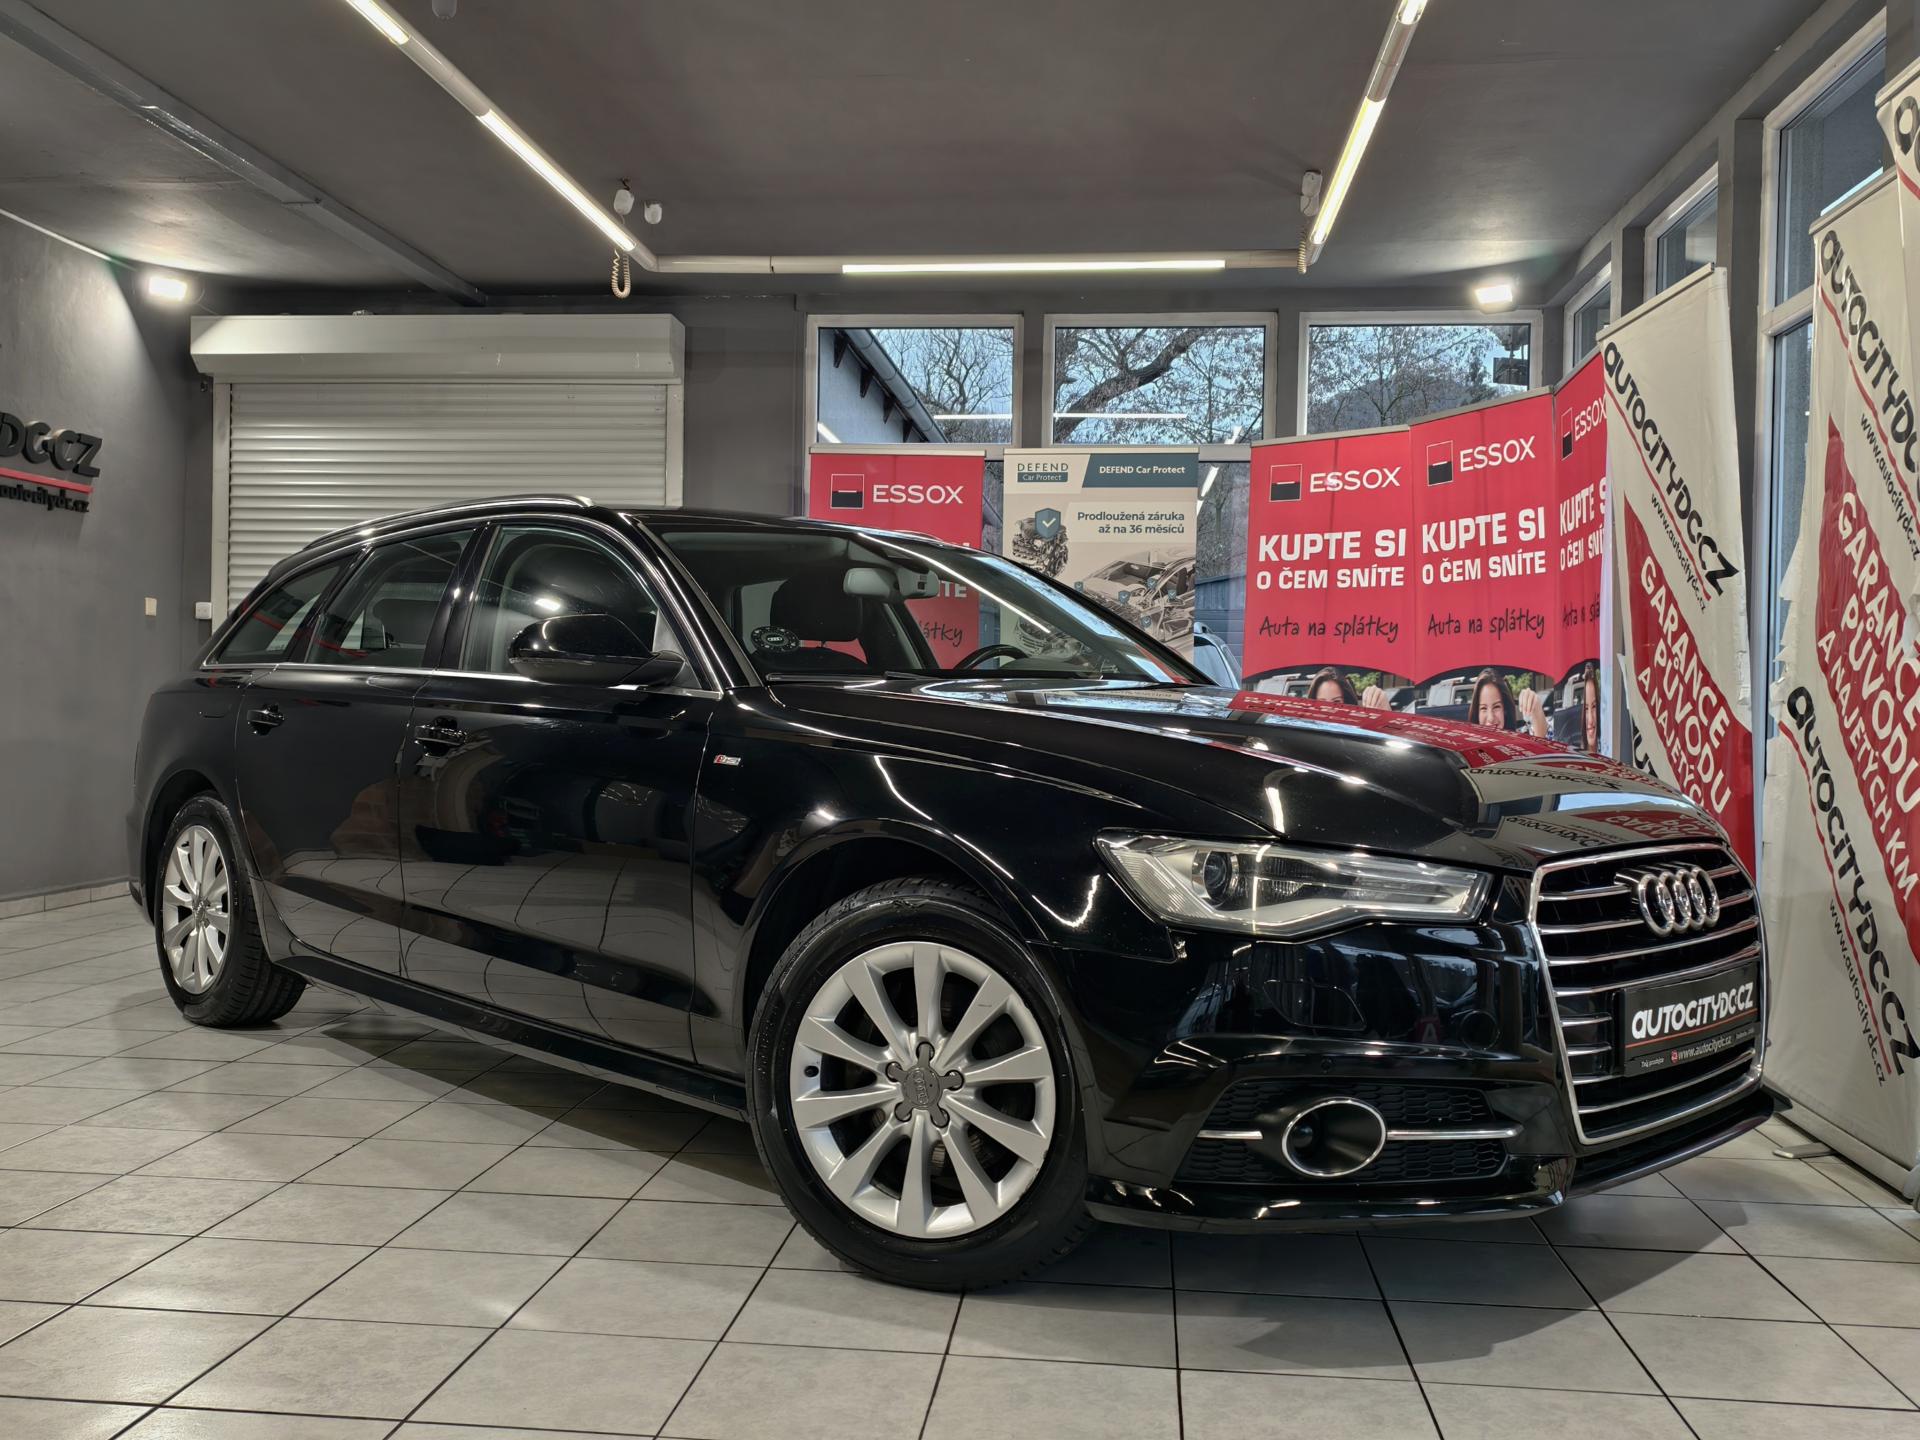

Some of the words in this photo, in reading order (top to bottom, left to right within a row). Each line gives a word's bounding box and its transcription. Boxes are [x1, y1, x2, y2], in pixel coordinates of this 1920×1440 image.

[1574, 397, 1607, 441] ESSOX
[1017, 463, 1069, 472] DEFEND
[1099, 465, 1133, 474] DEFEND
[1136, 465, 1151, 474] Car
[1152, 465, 1186, 474] Protect
[1459, 435, 1536, 472] ESSOX
[872, 484, 964, 505] ESSOX
[1309, 466, 1402, 493] ESSOX
[1077, 511, 1145, 521] Prodloužená
[1147, 511, 1185, 521] záruka
[1559, 483, 1595, 537] KUPTE
[1600, 477, 1607, 515] S
[1098, 524, 1111, 534] až
[1113, 526, 1127, 534] na
[1129, 525, 1143, 534] 36
[1145, 523, 1185, 534] měsíců
[1258, 530, 1362, 562] KUPTE
[1374, 528, 1407, 559] SI
[1422, 512, 1507, 554] KUPTE
[1518, 506, 1546, 542] SI
[1559, 547, 1566, 572] O
[1566, 538, 1585, 568] ČEM
[1588, 523, 1605, 560] SNÍ
[1652, 493, 1707, 614] www.autocitydc.cz
[1256, 570, 1272, 590] O
[1278, 566, 1328, 589] ČEM
[1336, 563, 1405, 588] SNÍTE
[1422, 563, 1434, 585] O
[1439, 557, 1482, 583] ČEM
[1488, 548, 1547, 578] SNÍTE
[1259, 615, 1300, 637] Auta
[1308, 621, 1326, 636] na
[1333, 615, 1399, 644] splátky
[1427, 612, 1461, 637] Auta
[1468, 617, 1483, 634] na
[1489, 607, 1545, 641] splátky
[1640, 555, 1730, 749] GARANCE
[1637, 666, 1651, 692] A
[1650, 691, 1705, 808] NAJETÝC
[1654, 638, 1732, 814] PŮVODU
[1817, 630, 1836, 658] A
[1829, 664, 1893, 834] NAJETÝCH
[1884, 828, 1919, 902] KM
[1829, 899, 1887, 1087] www.autocitydc.cz
